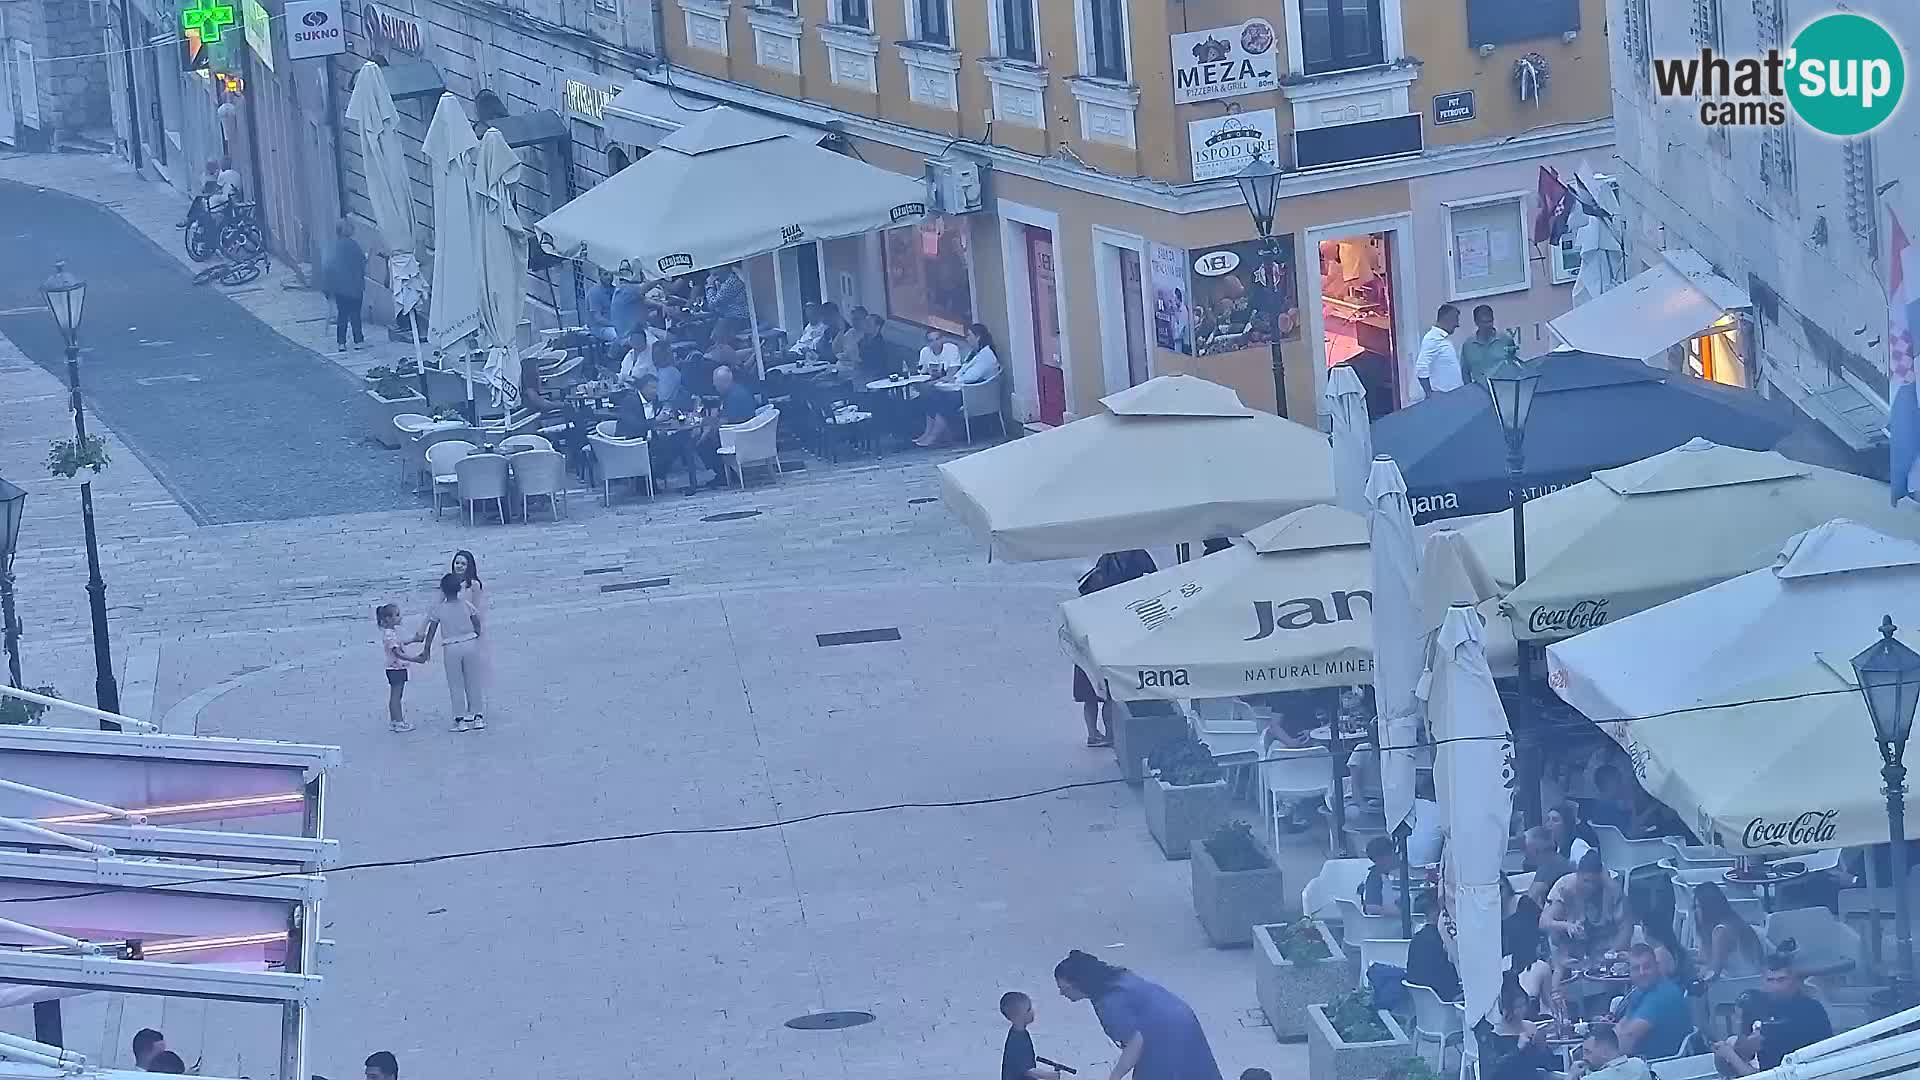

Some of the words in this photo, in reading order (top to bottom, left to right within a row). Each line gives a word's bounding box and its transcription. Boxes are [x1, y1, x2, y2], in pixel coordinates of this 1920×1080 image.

[294, 28, 339, 42] SUKNO
[381, 13, 420, 51] SUKNO
[1177, 59, 1256, 88] MEZA
[1186, 86, 1219, 97] PIZZERIA
[1227, 81, 1248, 91] GRILL
[1448, 98, 1460, 107] PUT
[1196, 144, 1241, 163] ISPOD
[1243, 589, 1374, 641] Jan
[1528, 599, 1610, 633] Coca-Cola
[1244, 664, 1320, 682] NATURAL
[1325, 659, 1375, 675] MINER
[1742, 809, 1839, 849] Coca-Cola
